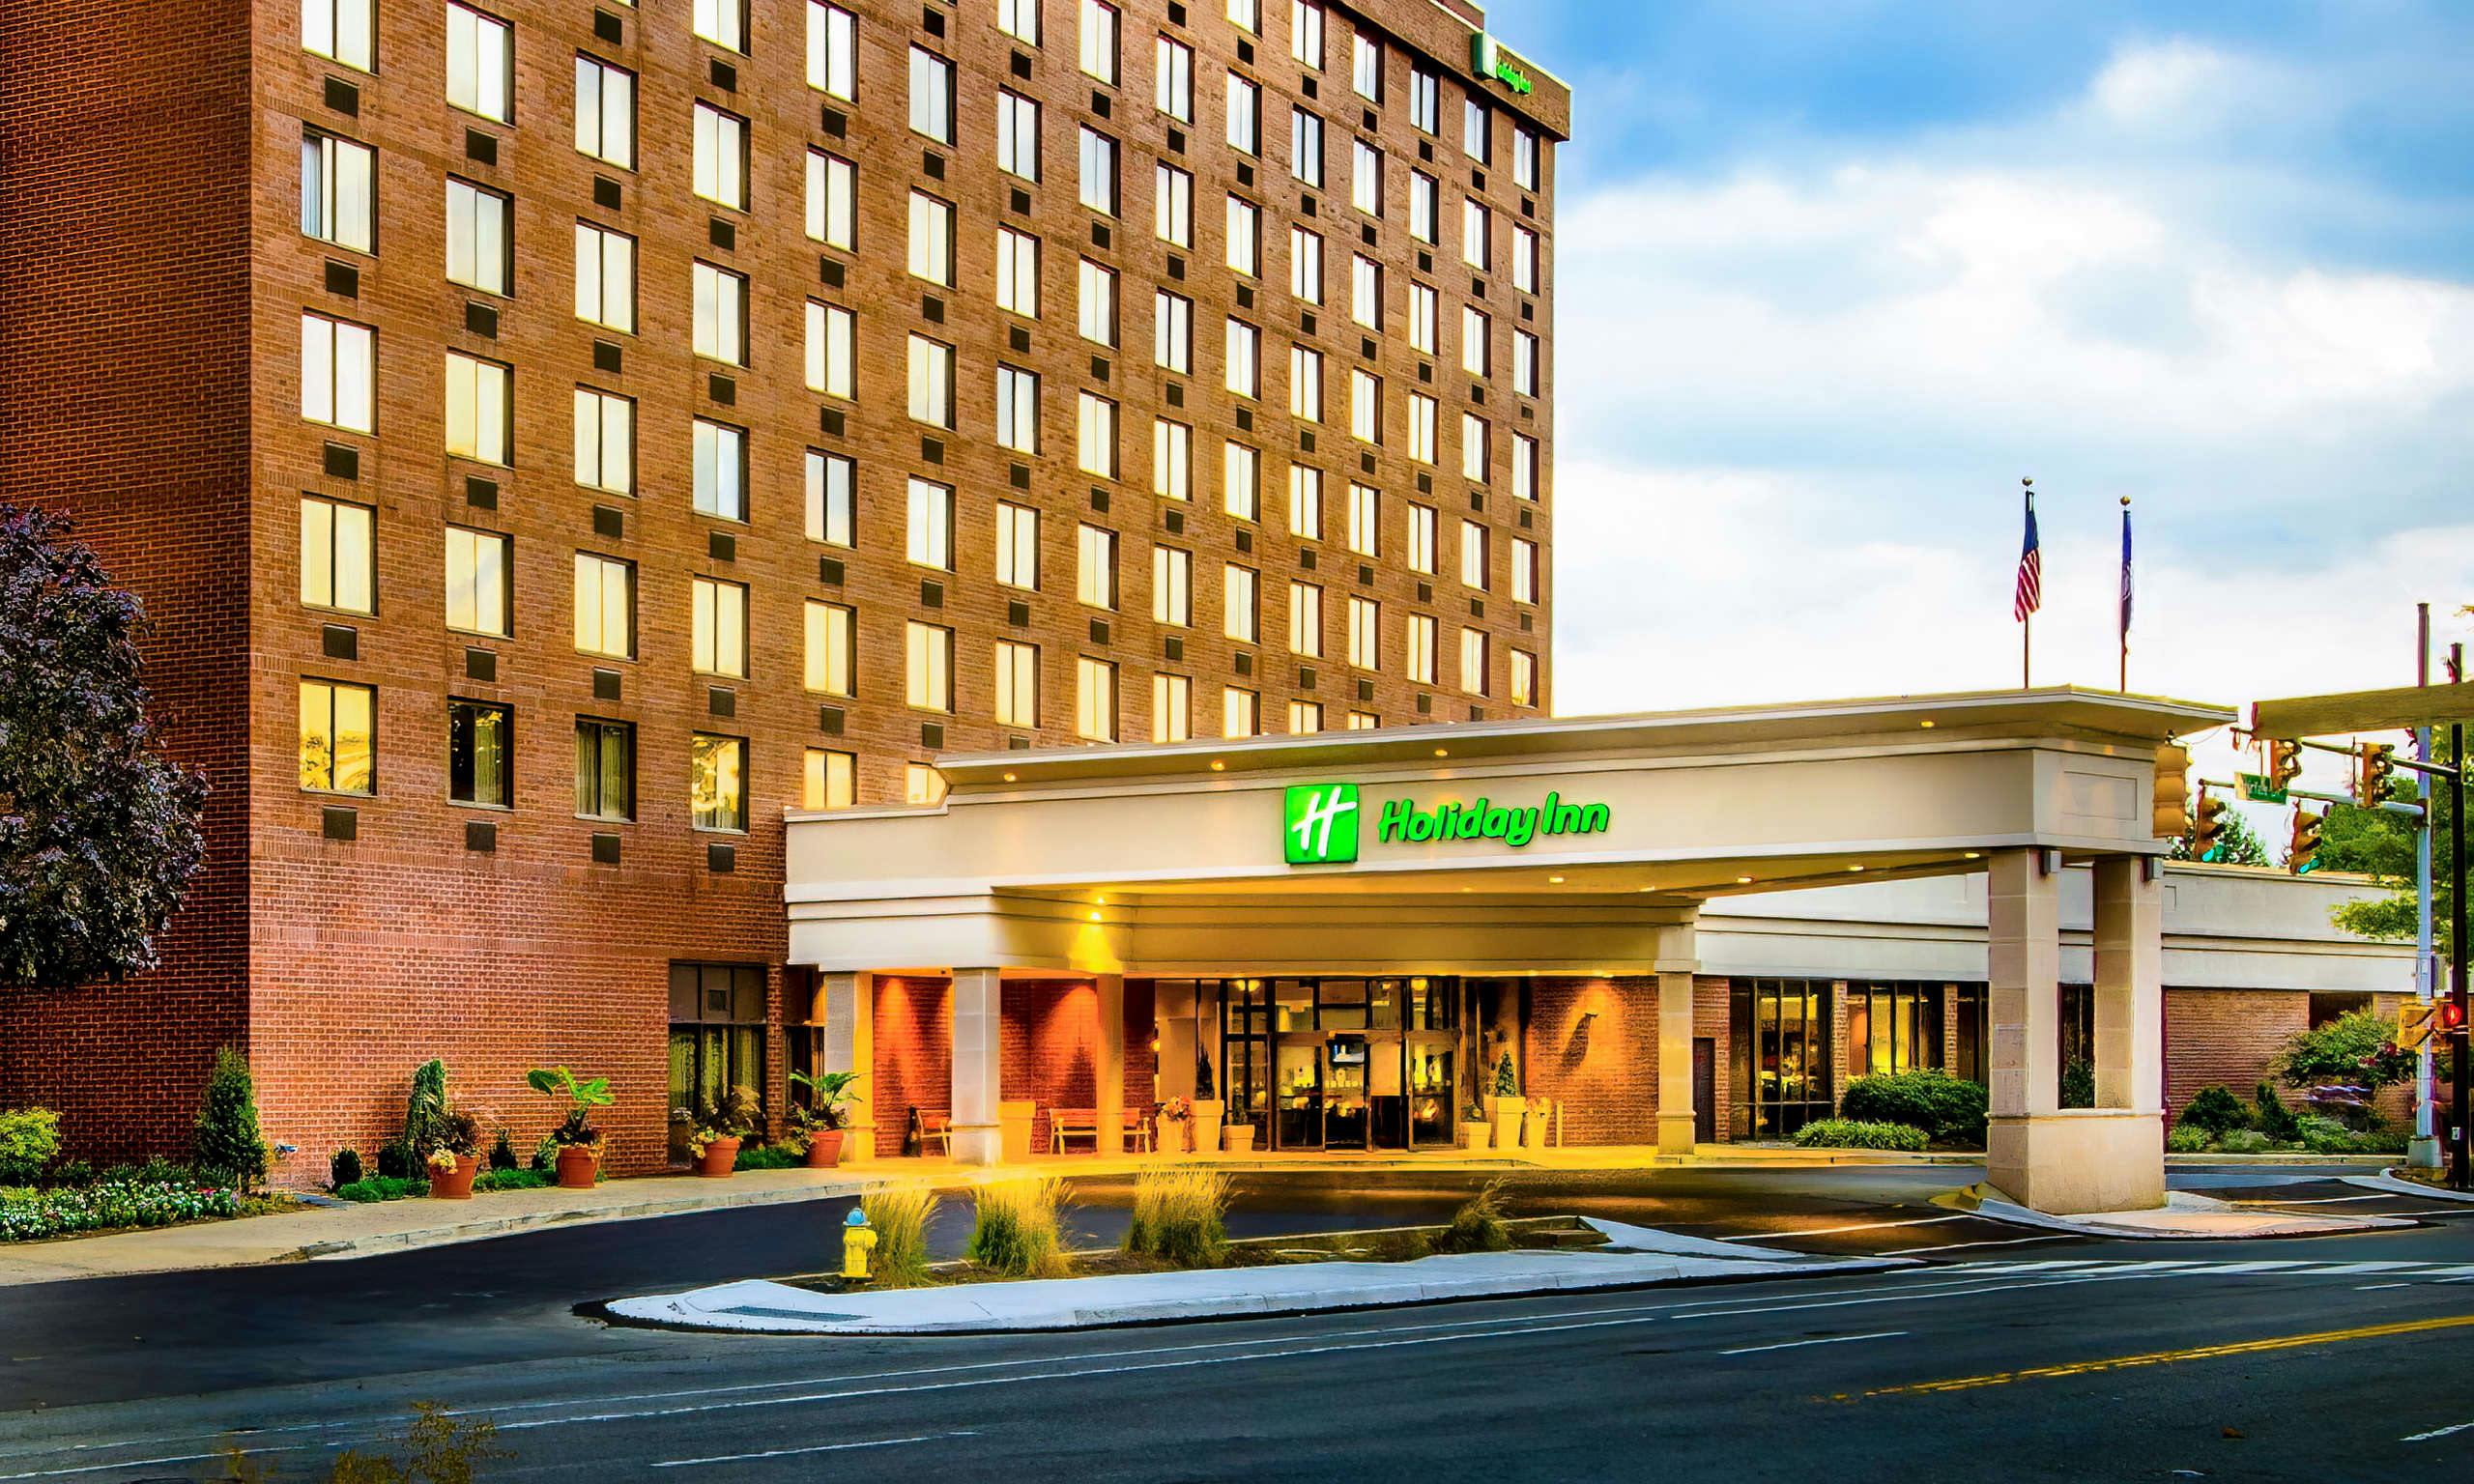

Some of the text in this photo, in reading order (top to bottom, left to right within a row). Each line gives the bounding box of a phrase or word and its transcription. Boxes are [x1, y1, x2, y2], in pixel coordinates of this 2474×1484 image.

[1292, 786, 1357, 857] H
[1378, 791, 1610, 846] Holiday Inn
